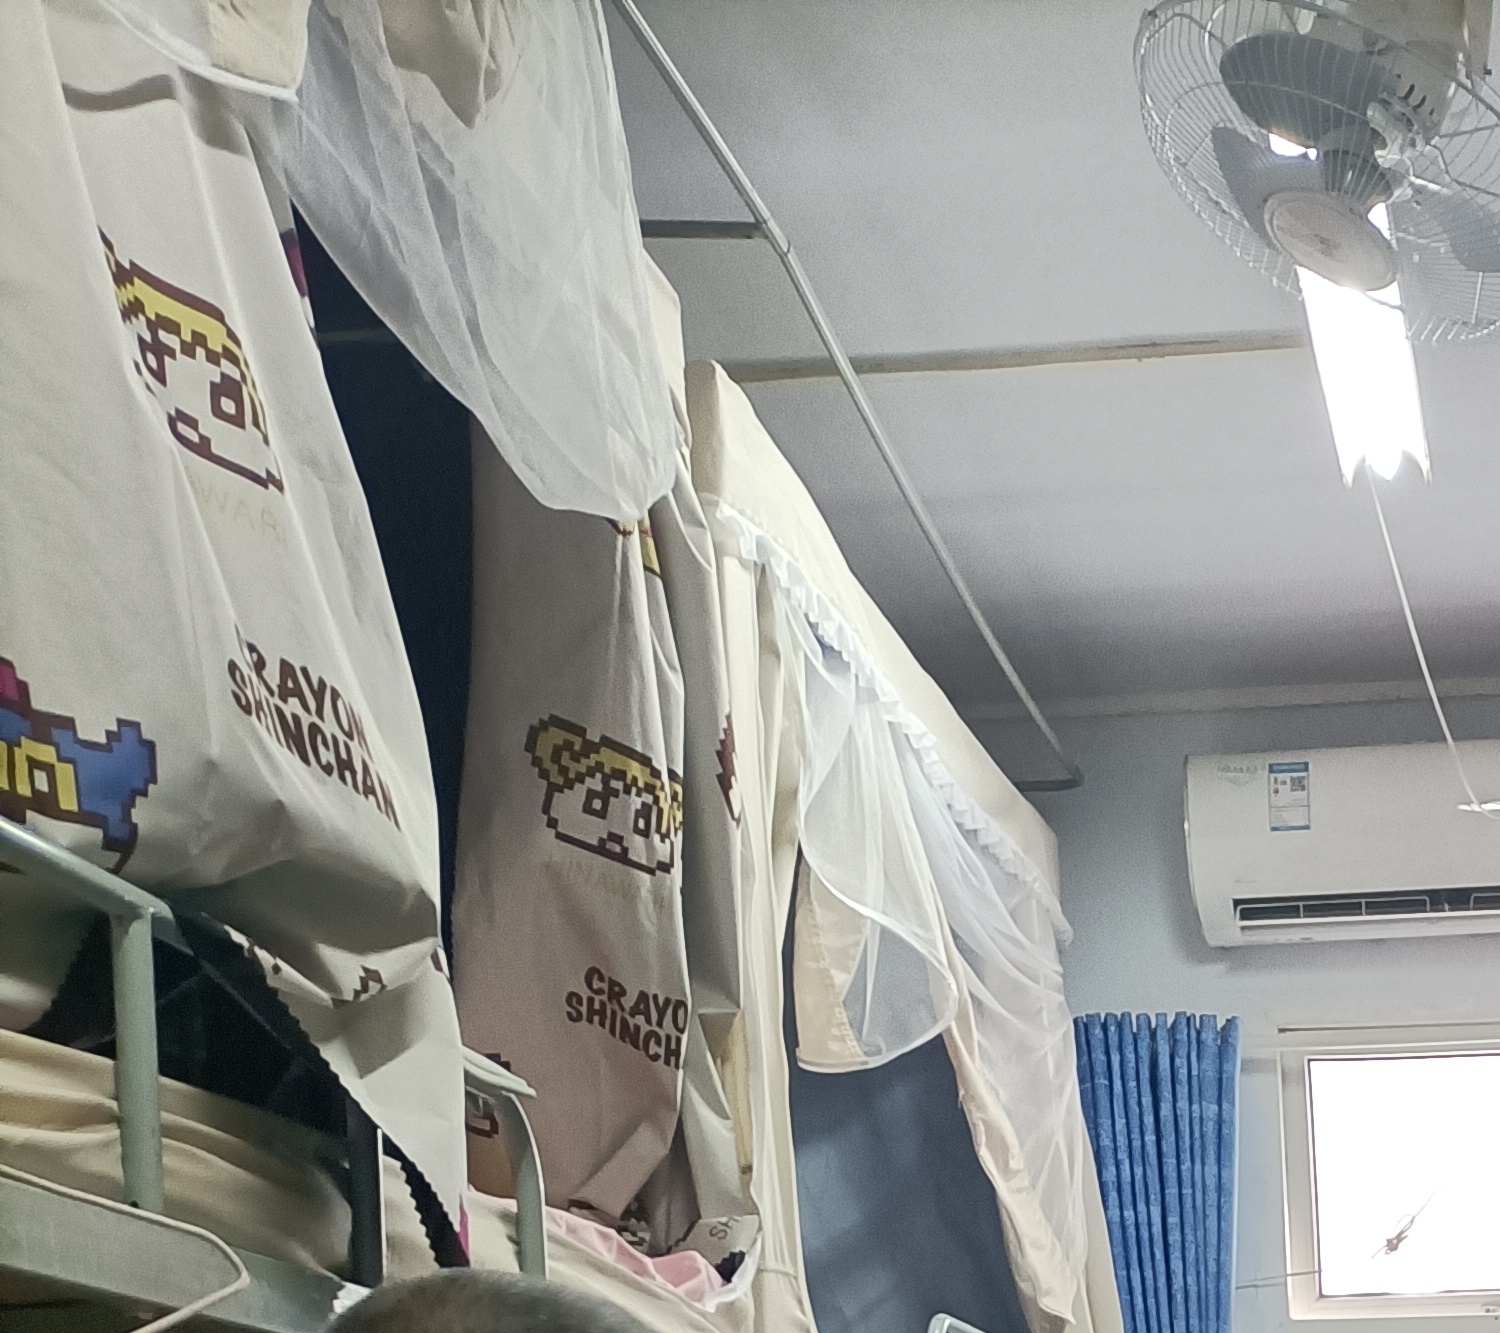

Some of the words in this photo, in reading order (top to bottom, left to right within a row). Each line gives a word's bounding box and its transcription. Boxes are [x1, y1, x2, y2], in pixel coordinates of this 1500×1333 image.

[227, 657, 401, 833] SHINCHAN
[565, 991, 684, 1071] SHINCH
[584, 966, 689, 1035] CRAYO
